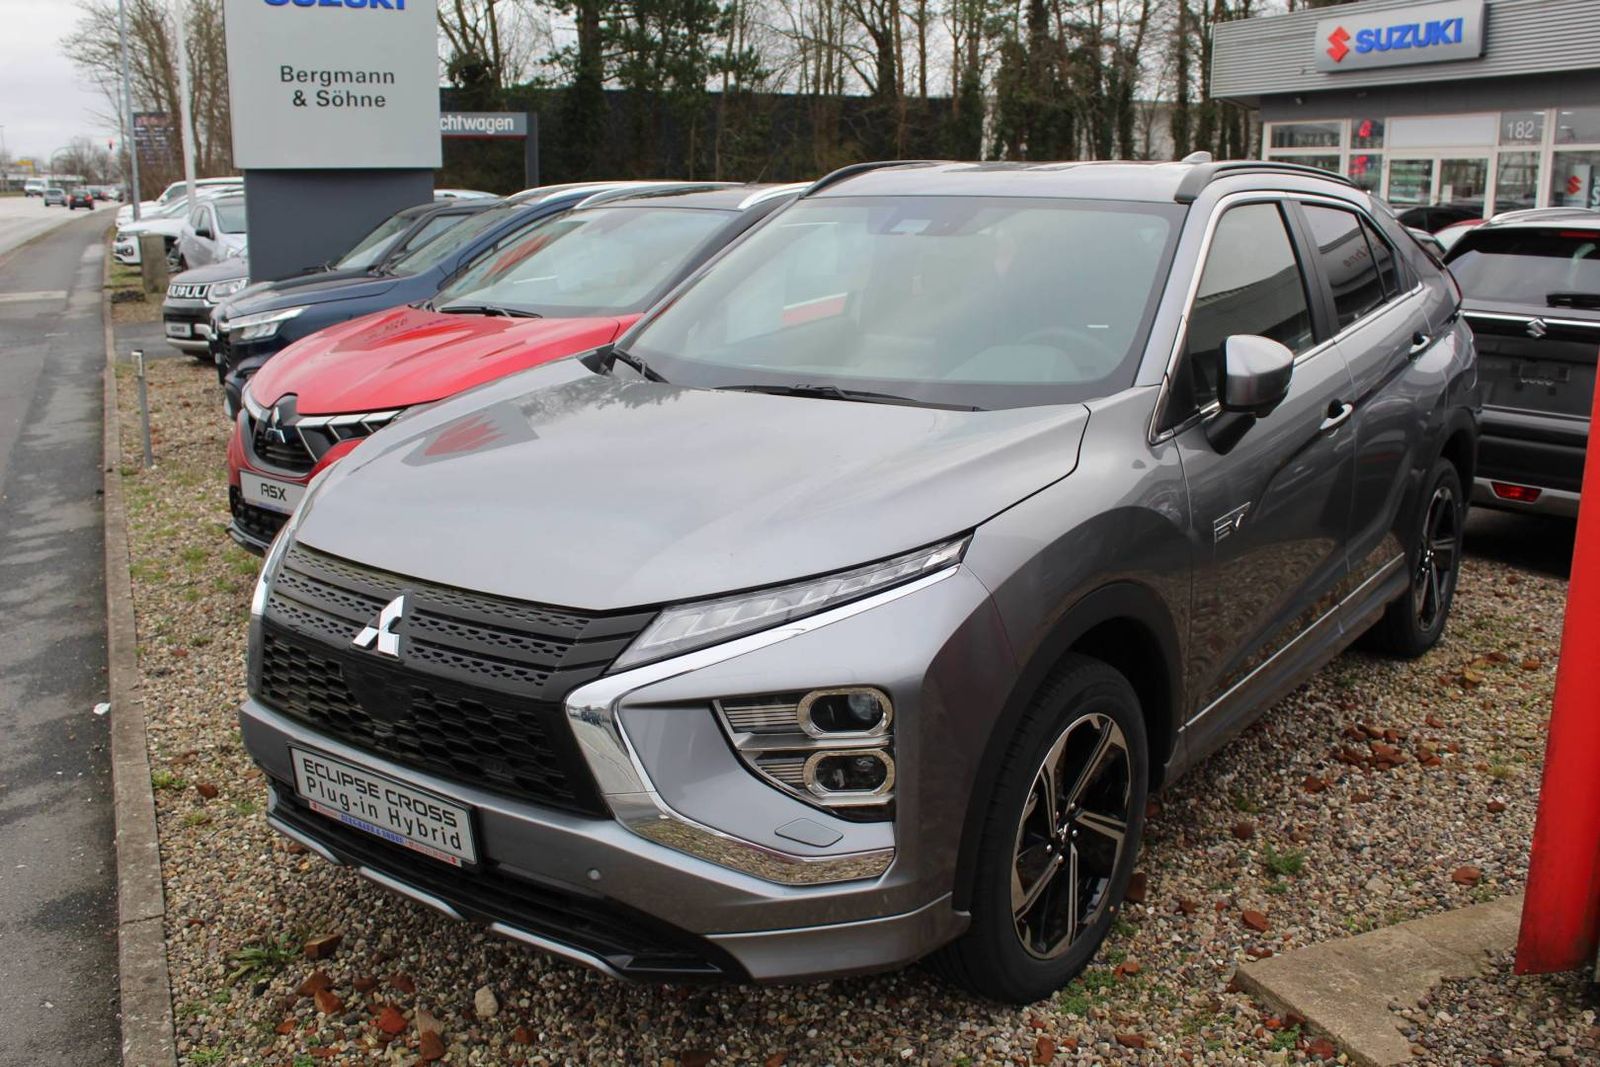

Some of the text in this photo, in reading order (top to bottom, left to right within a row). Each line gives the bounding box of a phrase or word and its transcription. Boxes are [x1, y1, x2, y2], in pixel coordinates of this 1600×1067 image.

[1355, 17, 1463, 54] SUZUKI
[280, 65, 395, 87] Bergmann
[292, 89, 386, 108] & Söhne
[440, 114, 514, 134] chtwagen
[1507, 121, 1535, 139] 182
[261, 482, 287, 501] ASX
[303, 758, 458, 828] ECLIPSE CROSS
[306, 776, 379, 819] Plug-in
[388, 807, 462, 850] Hybrid
